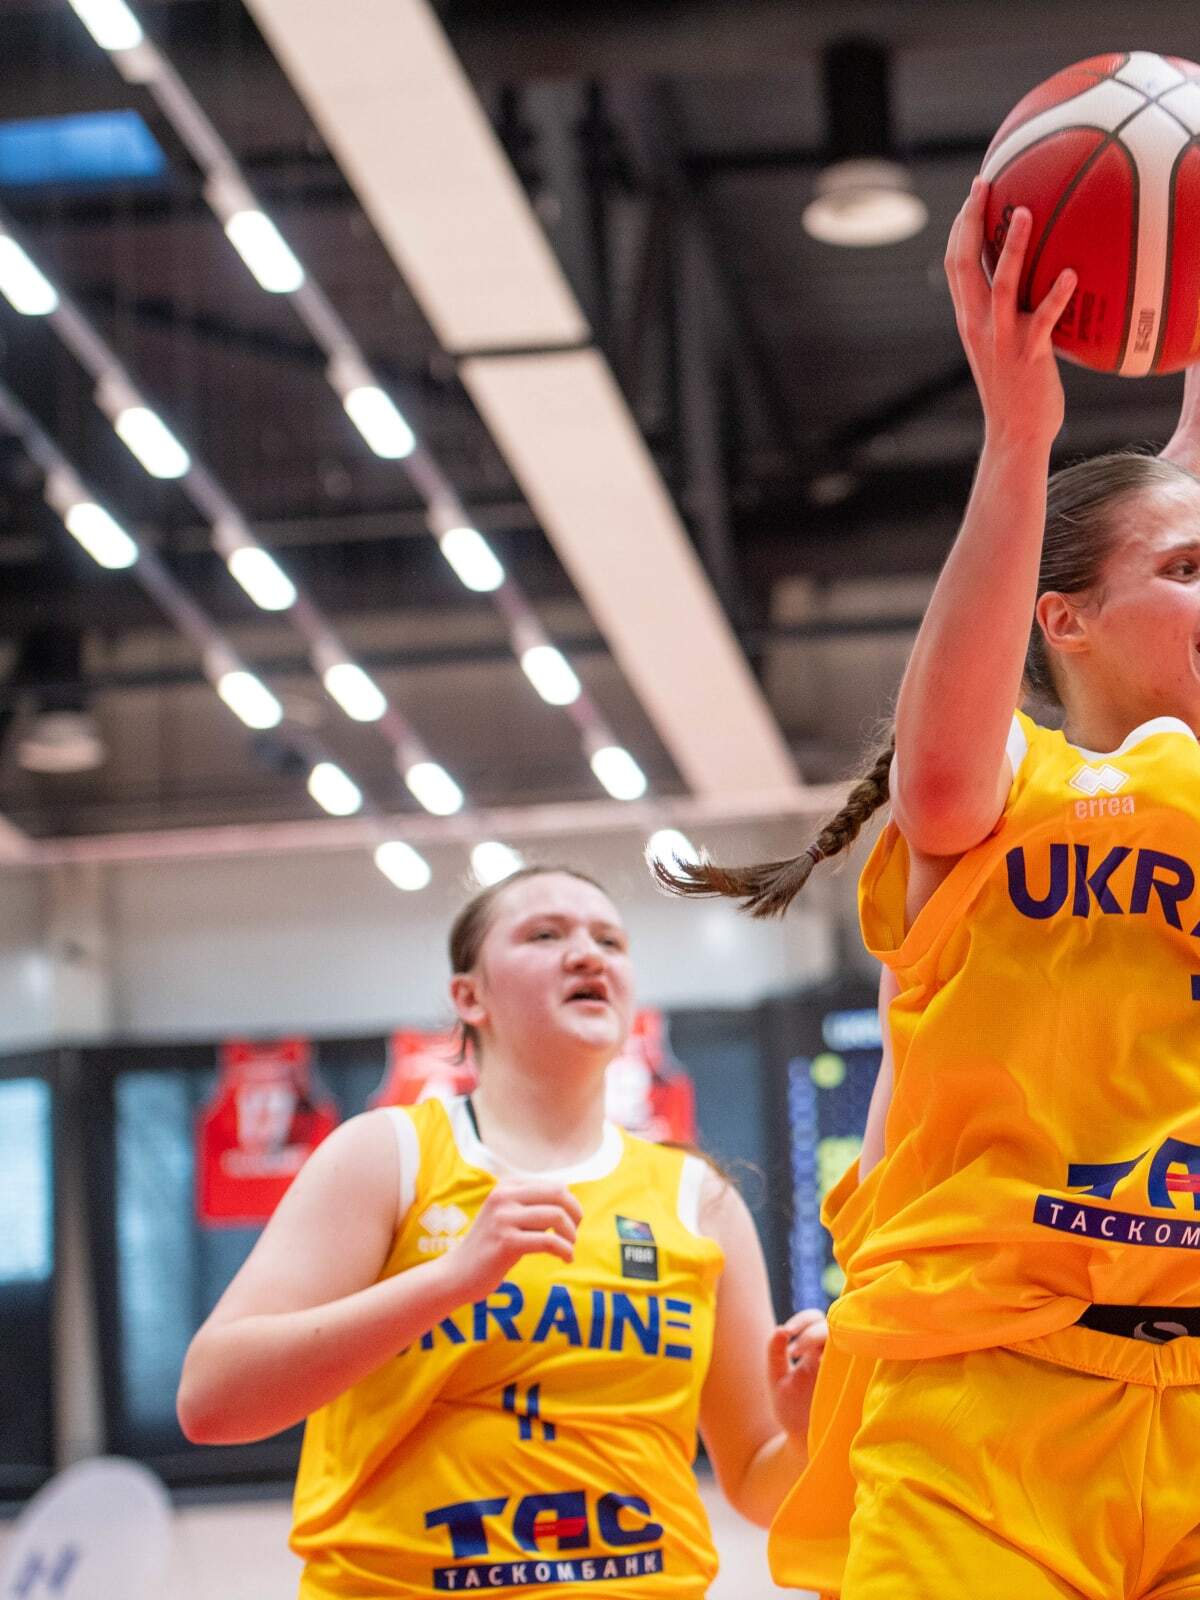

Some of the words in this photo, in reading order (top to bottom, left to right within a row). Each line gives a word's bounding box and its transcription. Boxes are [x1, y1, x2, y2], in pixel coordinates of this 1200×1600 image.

[1074, 796, 1135, 820] errea
[624, 1246, 654, 1264] FIBA
[445, 1555, 658, 1589] ТАСКОМБАНК
